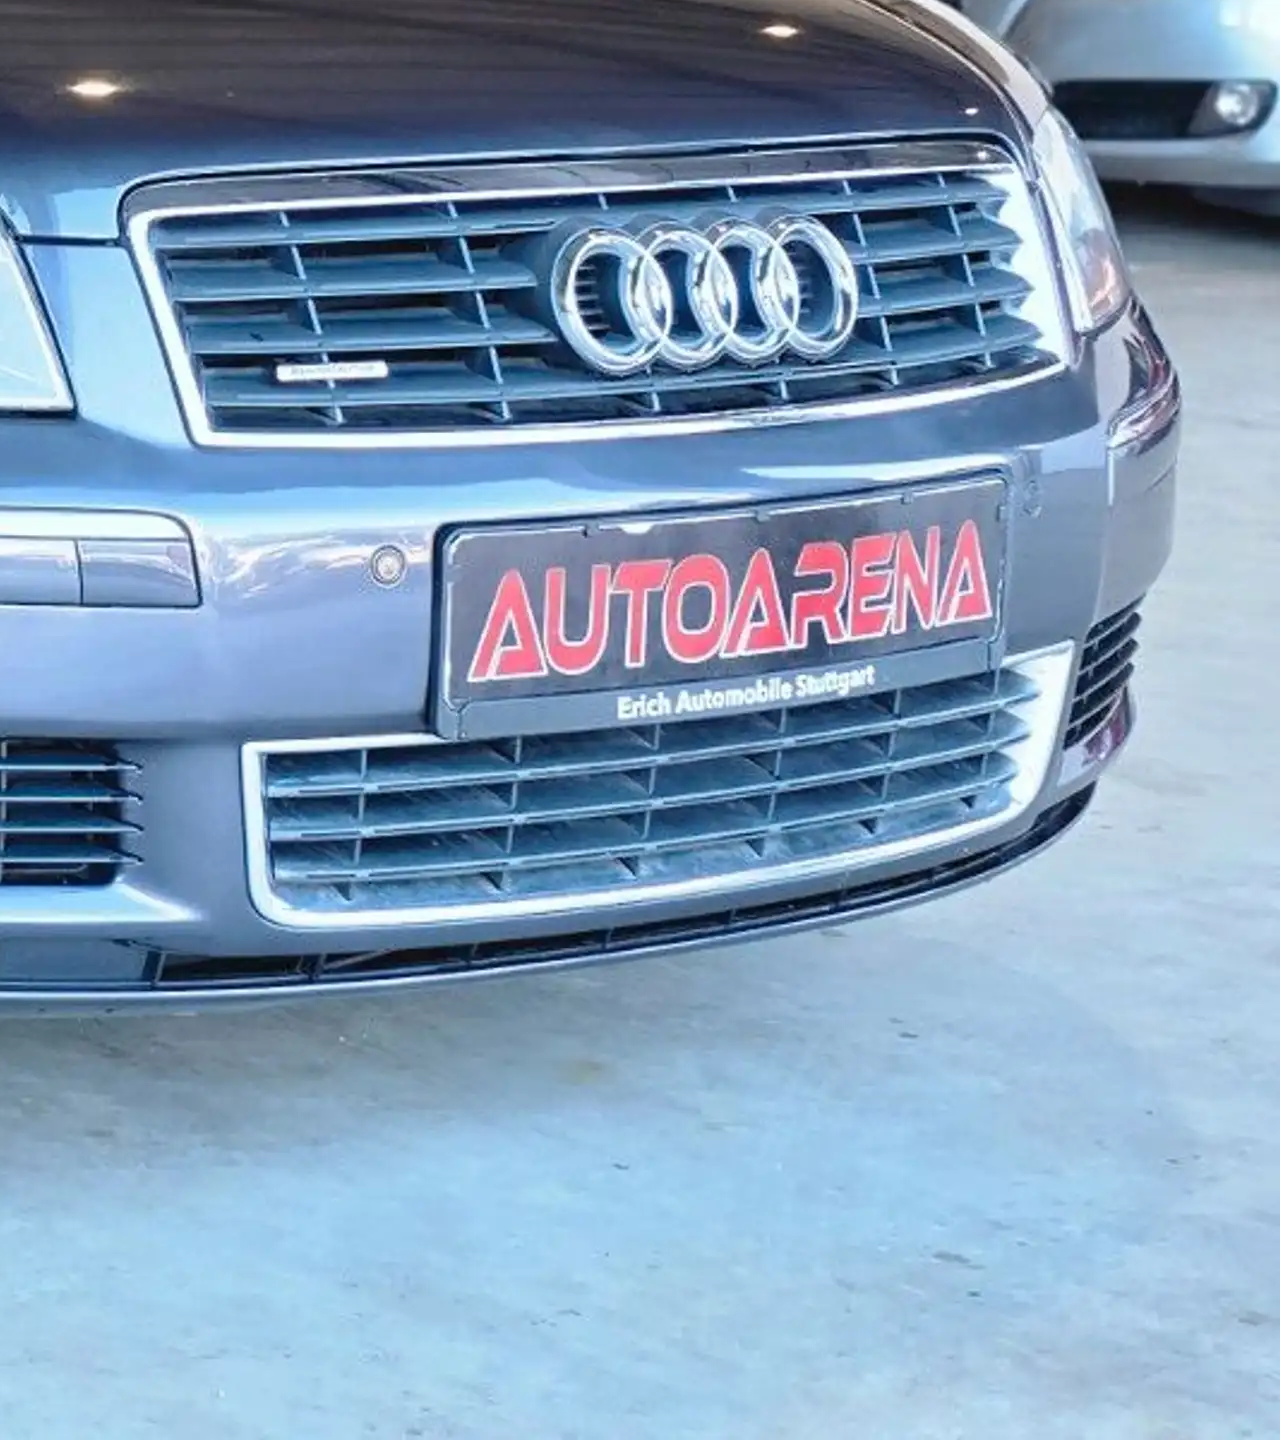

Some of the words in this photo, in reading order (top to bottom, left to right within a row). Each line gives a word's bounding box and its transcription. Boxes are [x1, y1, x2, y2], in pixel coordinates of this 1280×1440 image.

[467, 518, 993, 682] AUTOARENA
[617, 690, 672, 720] Erich
[675, 676, 793, 715] Automobile
[795, 664, 877, 698] Stuttgart
